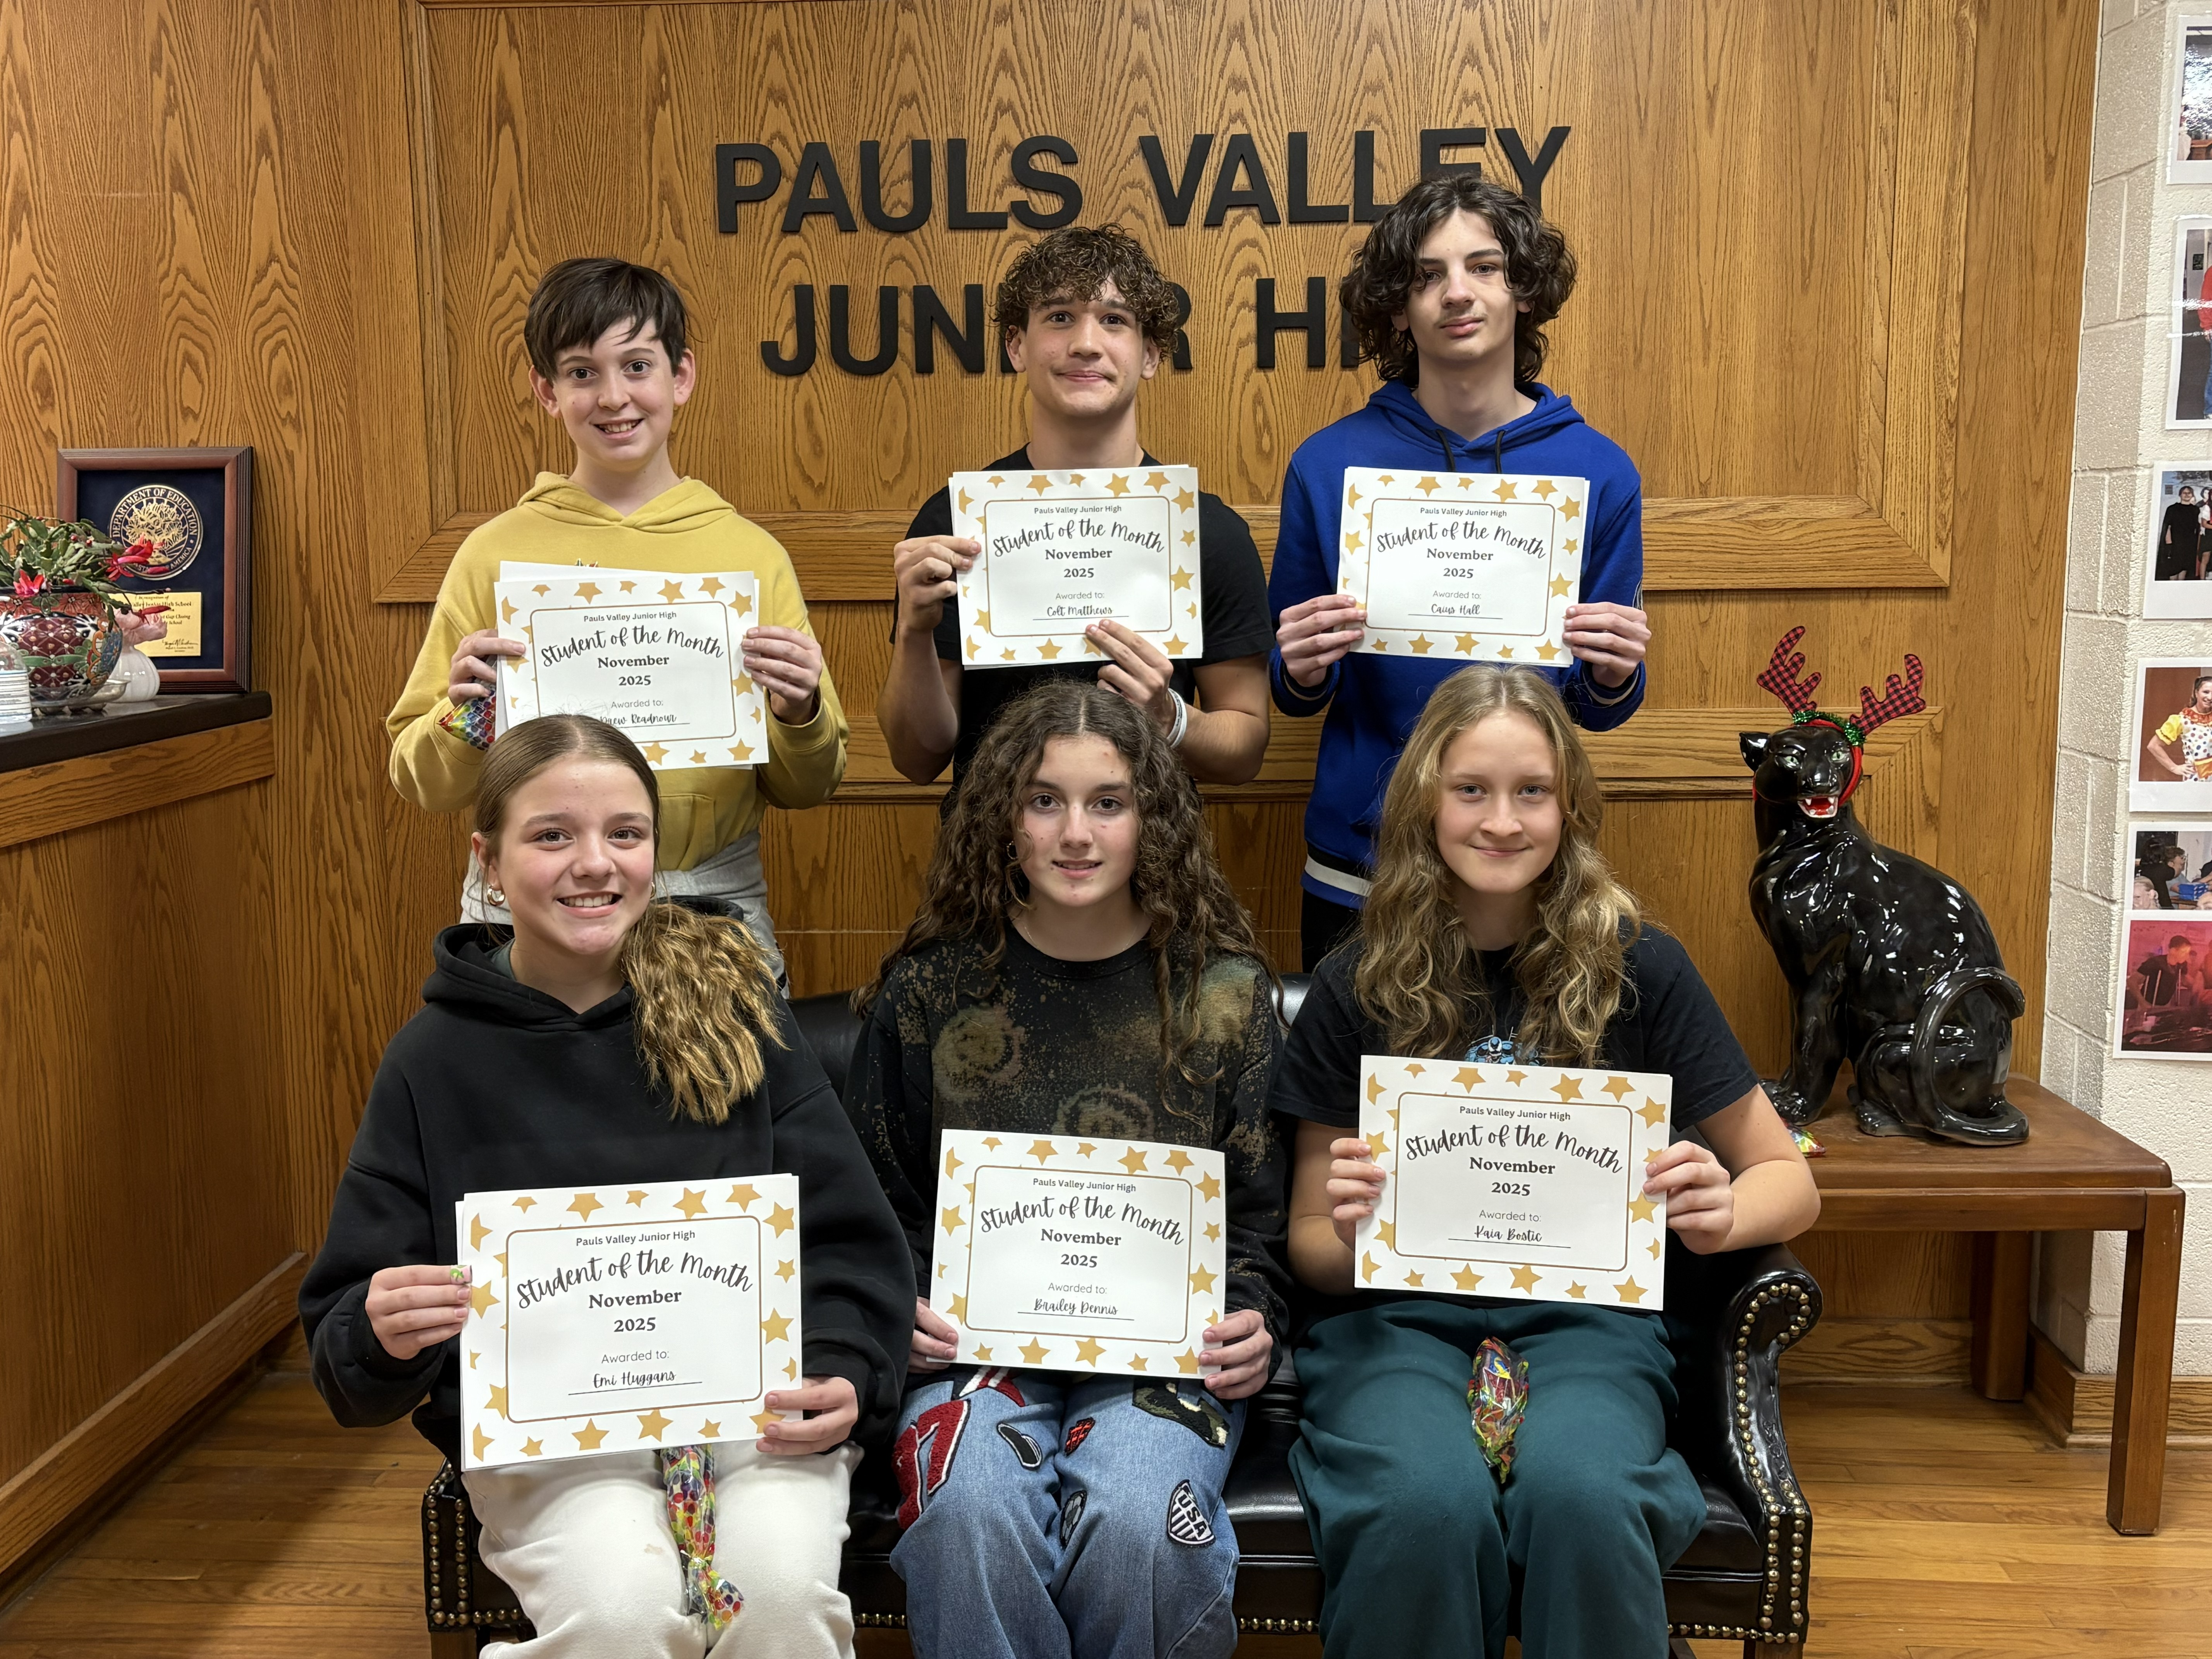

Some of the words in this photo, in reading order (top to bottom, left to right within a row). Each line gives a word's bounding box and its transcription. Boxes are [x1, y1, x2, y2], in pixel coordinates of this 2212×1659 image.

[716, 135, 1084, 233] PAULS
[1139, 126, 1571, 226] VALLEY
[1256, 276, 1361, 368] HI
[112, 488, 151, 538] DEPARTMENT
[153, 488, 167, 496] OF
[167, 491, 198, 536] EDUCATION
[1055, 507, 1078, 515] Valley
[1105, 505, 1121, 514] High
[1441, 508, 1464, 517] Valley
[1490, 510, 1507, 518] High
[993, 522, 1056, 560] Student
[1058, 519, 1075, 539] of
[1078, 518, 1106, 538] the
[1111, 521, 1164, 553] Month
[1377, 522, 1438, 553] Student
[1441, 521, 1459, 540] of
[1463, 521, 1489, 540] the
[1494, 526, 1546, 559] Month
[170, 547, 192, 569] AMERICA
[1045, 548, 1113, 560] November
[1427, 548, 1494, 560] November
[1064, 568, 1094, 578] 2025
[1443, 568, 1474, 579] 2025
[1055, 591, 1092, 600] Awarded
[1432, 590, 1469, 599] Awarded
[606, 613, 630, 622] Valley
[659, 611, 677, 620] High
[1047, 605, 1066, 617] Colt
[1068, 605, 1114, 616] Matthews
[1431, 603, 1455, 615] Caius
[1460, 604, 1480, 615] Hall
[541, 630, 609, 668] Student
[610, 627, 629, 647] of
[632, 625, 661, 645] the
[667, 627, 724, 658] Month
[597, 654, 670, 668] November
[618, 675, 651, 686] 2025
[611, 699, 650, 708] Awarded
[631, 713, 677, 724] Readnour
[1460, 1106, 1484, 1115] Pauls
[1486, 1108, 1515, 1119] Valley
[1517, 1109, 1547, 1119] Junior
[1549, 1111, 1571, 1122] High
[1405, 1124, 1484, 1161] Student
[1488, 1124, 1510, 1147] of
[1514, 1124, 1549, 1148] the
[1555, 1131, 1623, 1173] Month
[1469, 1157, 1556, 1174] November
[1033, 1178, 1056, 1187] Pauls
[1058, 1180, 1085, 1190] Valley
[1086, 1182, 1115, 1190] Junior
[1116, 1183, 1136, 1194] High
[1491, 1182, 1530, 1196] 2025
[981, 1196, 1055, 1233] Student
[1059, 1196, 1080, 1219] of
[1084, 1196, 1116, 1219] the
[1121, 1202, 1184, 1245] Month
[1479, 1209, 1525, 1221] Awarded
[1529, 1213, 1541, 1222] to:
[576, 1236, 603, 1247] Pauls
[605, 1234, 636, 1245] Valley
[638, 1232, 671, 1242] Junior
[673, 1230, 695, 1241] High
[1041, 1228, 1121, 1246] November
[1474, 1225, 1503, 1240] Kaia
[1506, 1228, 1542, 1242] Bostic
[1060, 1254, 1098, 1268] 2025
[517, 1257, 604, 1309] Student
[608, 1252, 632, 1279] of
[636, 1249, 674, 1276] the
[680, 1252, 753, 1292] Month
[1048, 1282, 1092, 1293] Awarded
[1096, 1286, 1107, 1294] to:
[588, 1289, 682, 1309] November
[1034, 1298, 1077, 1315] Brailey
[1080, 1301, 1118, 1315] Dennis
[613, 1317, 656, 1333] 2025
[601, 1350, 652, 1364] Awarded
[656, 1350, 669, 1359] to:
[592, 1373, 617, 1388] Emi
[621, 1371, 677, 1386] Huggans
[1178, 1494, 1207, 1538] USA
